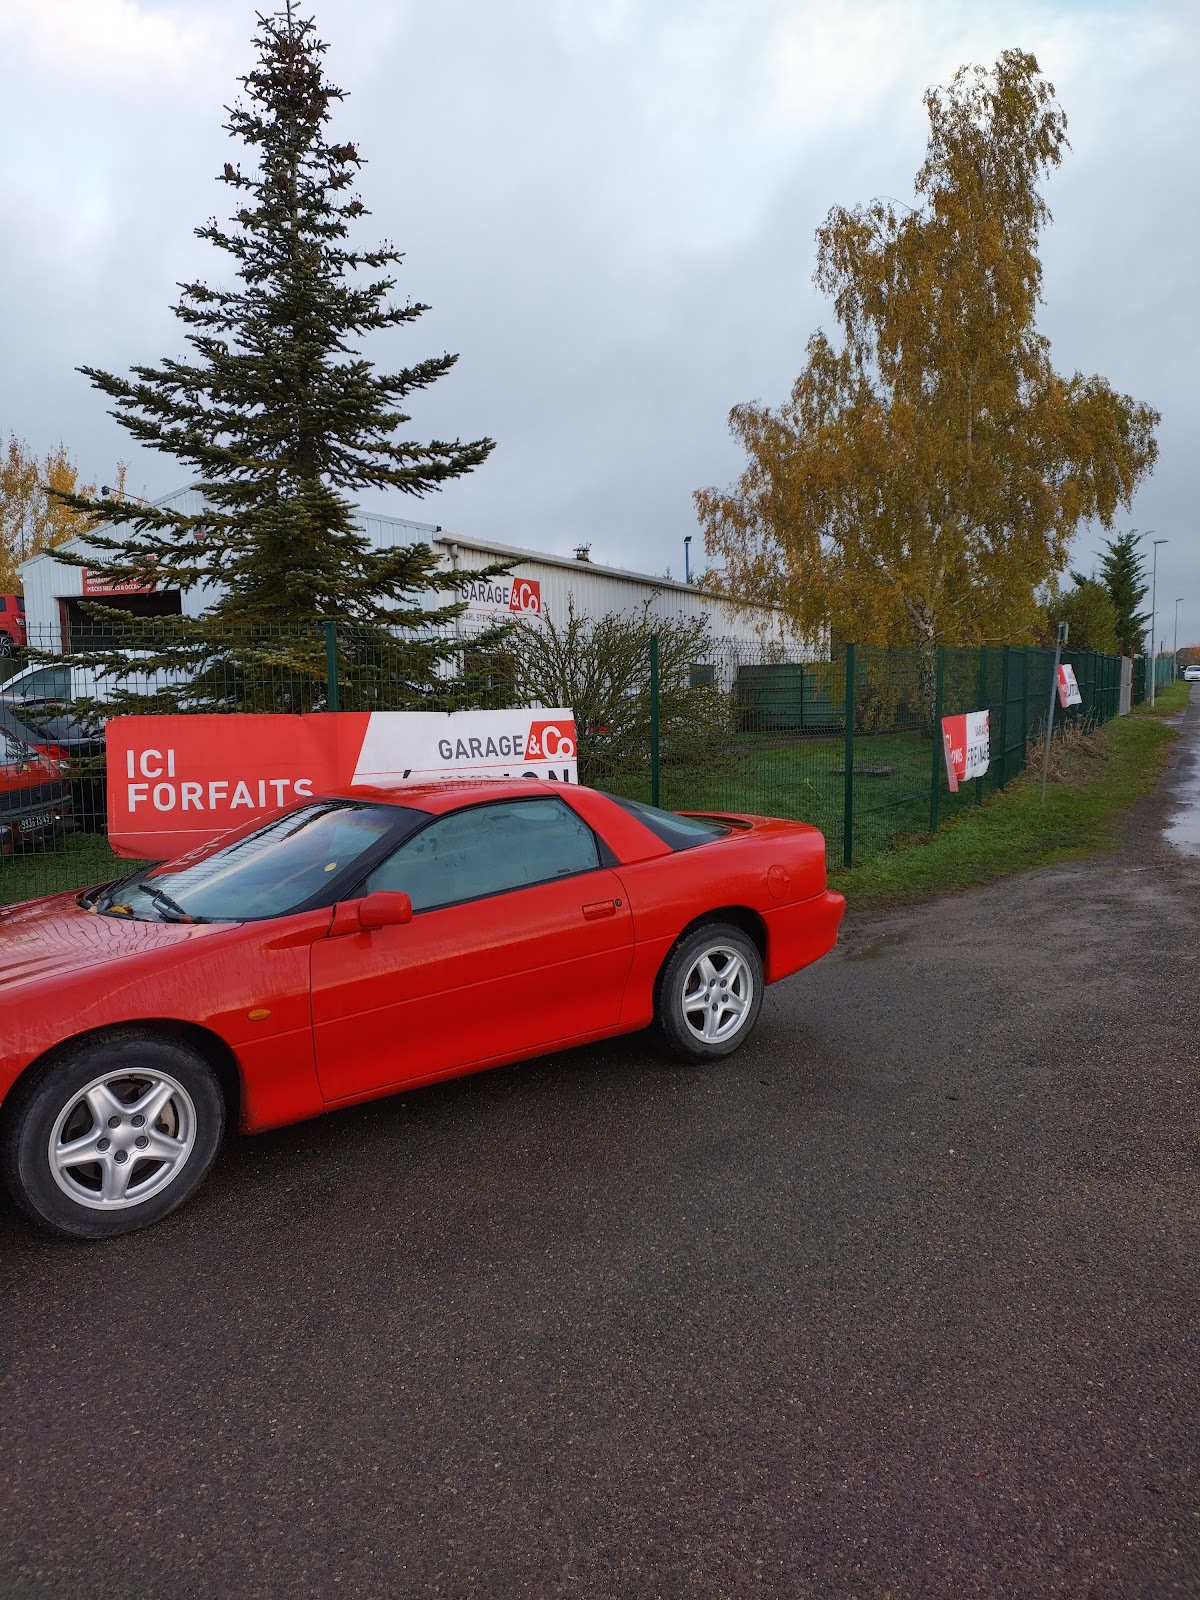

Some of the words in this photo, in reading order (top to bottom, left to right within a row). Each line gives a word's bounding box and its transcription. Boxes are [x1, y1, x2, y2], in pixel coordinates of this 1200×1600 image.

[461, 583, 510, 604] GARAGE
[438, 735, 525, 760] GARAGE
[126, 749, 176, 779] ICI
[127, 779, 314, 813] FORFAITS
